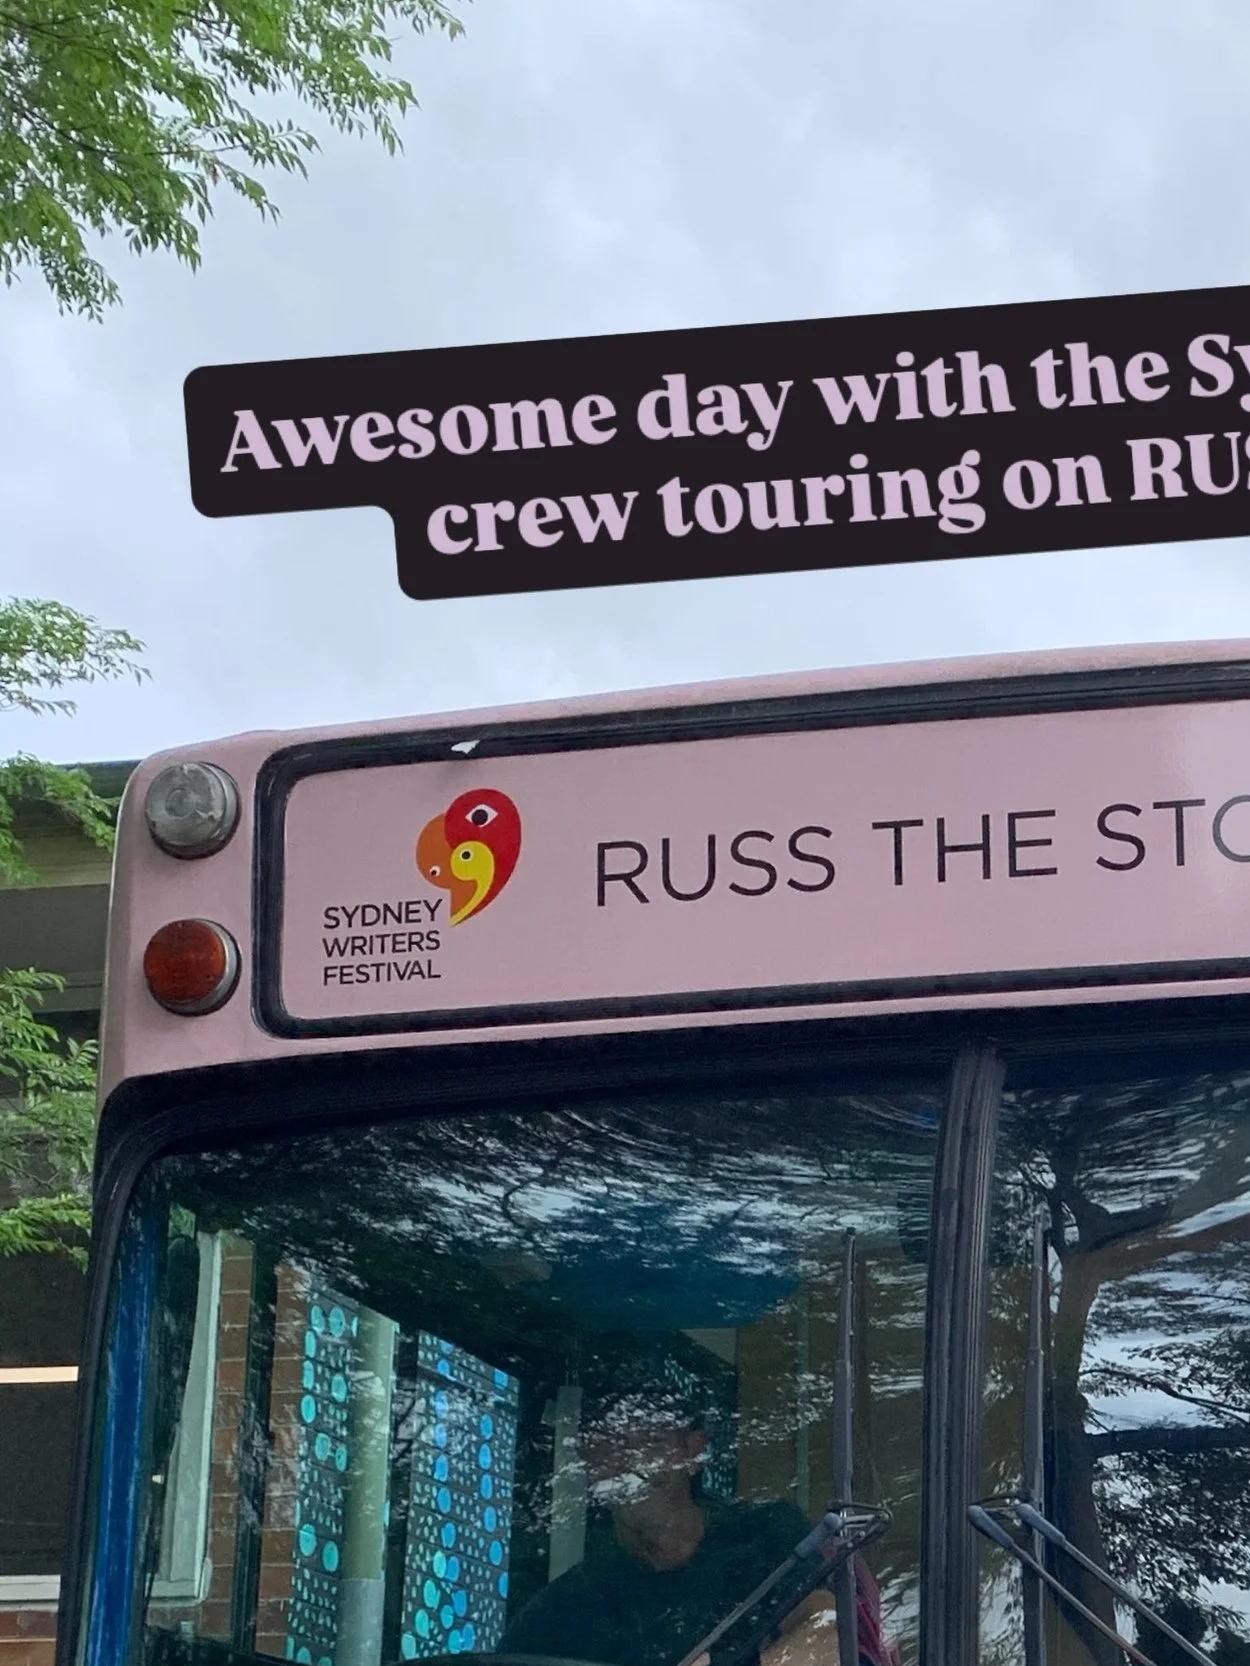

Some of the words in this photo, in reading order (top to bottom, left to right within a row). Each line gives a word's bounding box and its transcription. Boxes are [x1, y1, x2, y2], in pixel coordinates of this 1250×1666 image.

[596, 826, 836, 906] RUSS
[872, 809, 1058, 886] THE
[323, 898, 443, 930] SYDNEY
[322, 930, 441, 958] WRITERS
[323, 959, 442, 987] FESTIVAL
